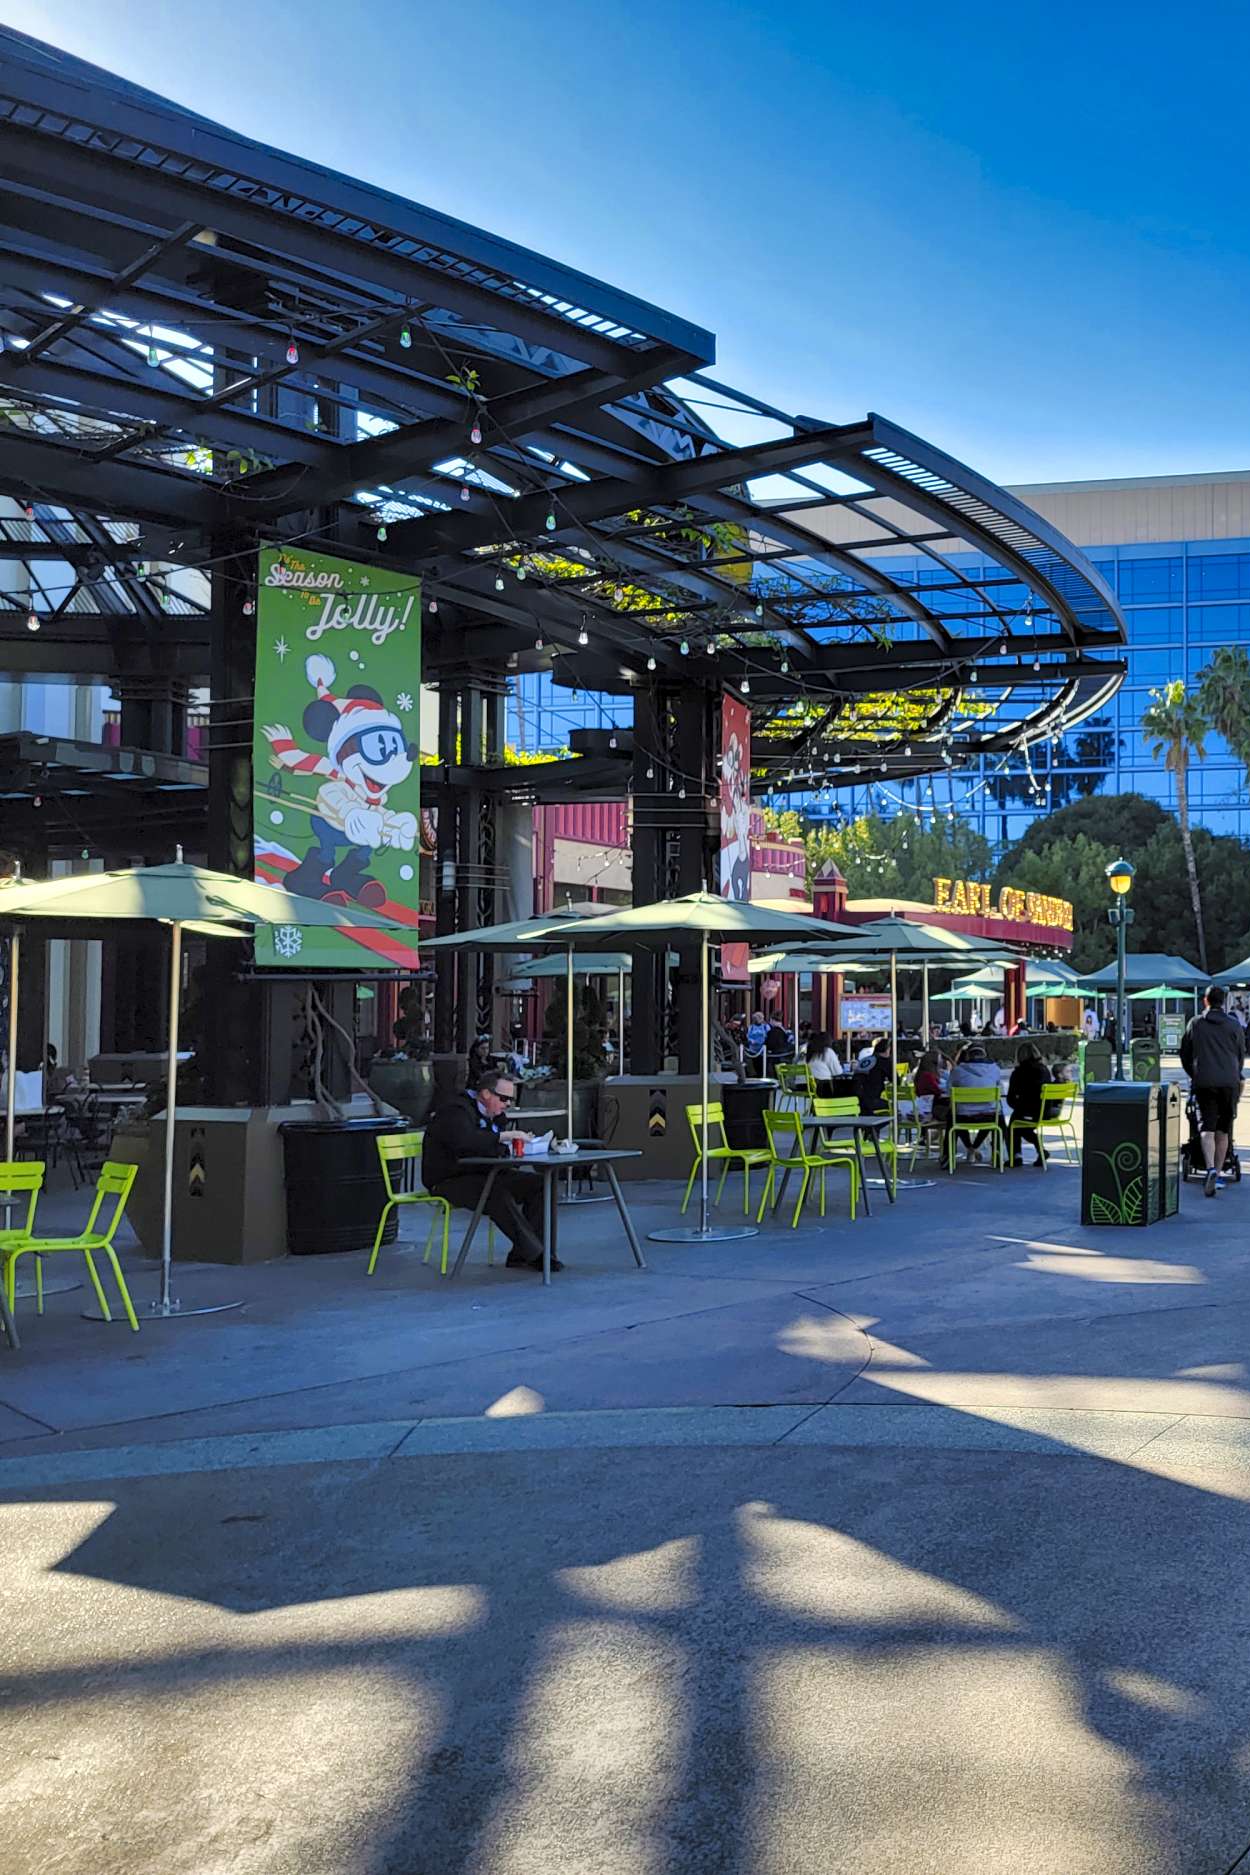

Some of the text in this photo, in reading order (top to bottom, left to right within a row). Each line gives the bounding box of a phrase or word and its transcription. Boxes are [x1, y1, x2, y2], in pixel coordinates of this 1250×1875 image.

[265, 563, 343, 588] Season
[306, 593, 414, 645] Jolly!
[933, 877, 992, 918] EARL
[999, 886, 1026, 922] OF
